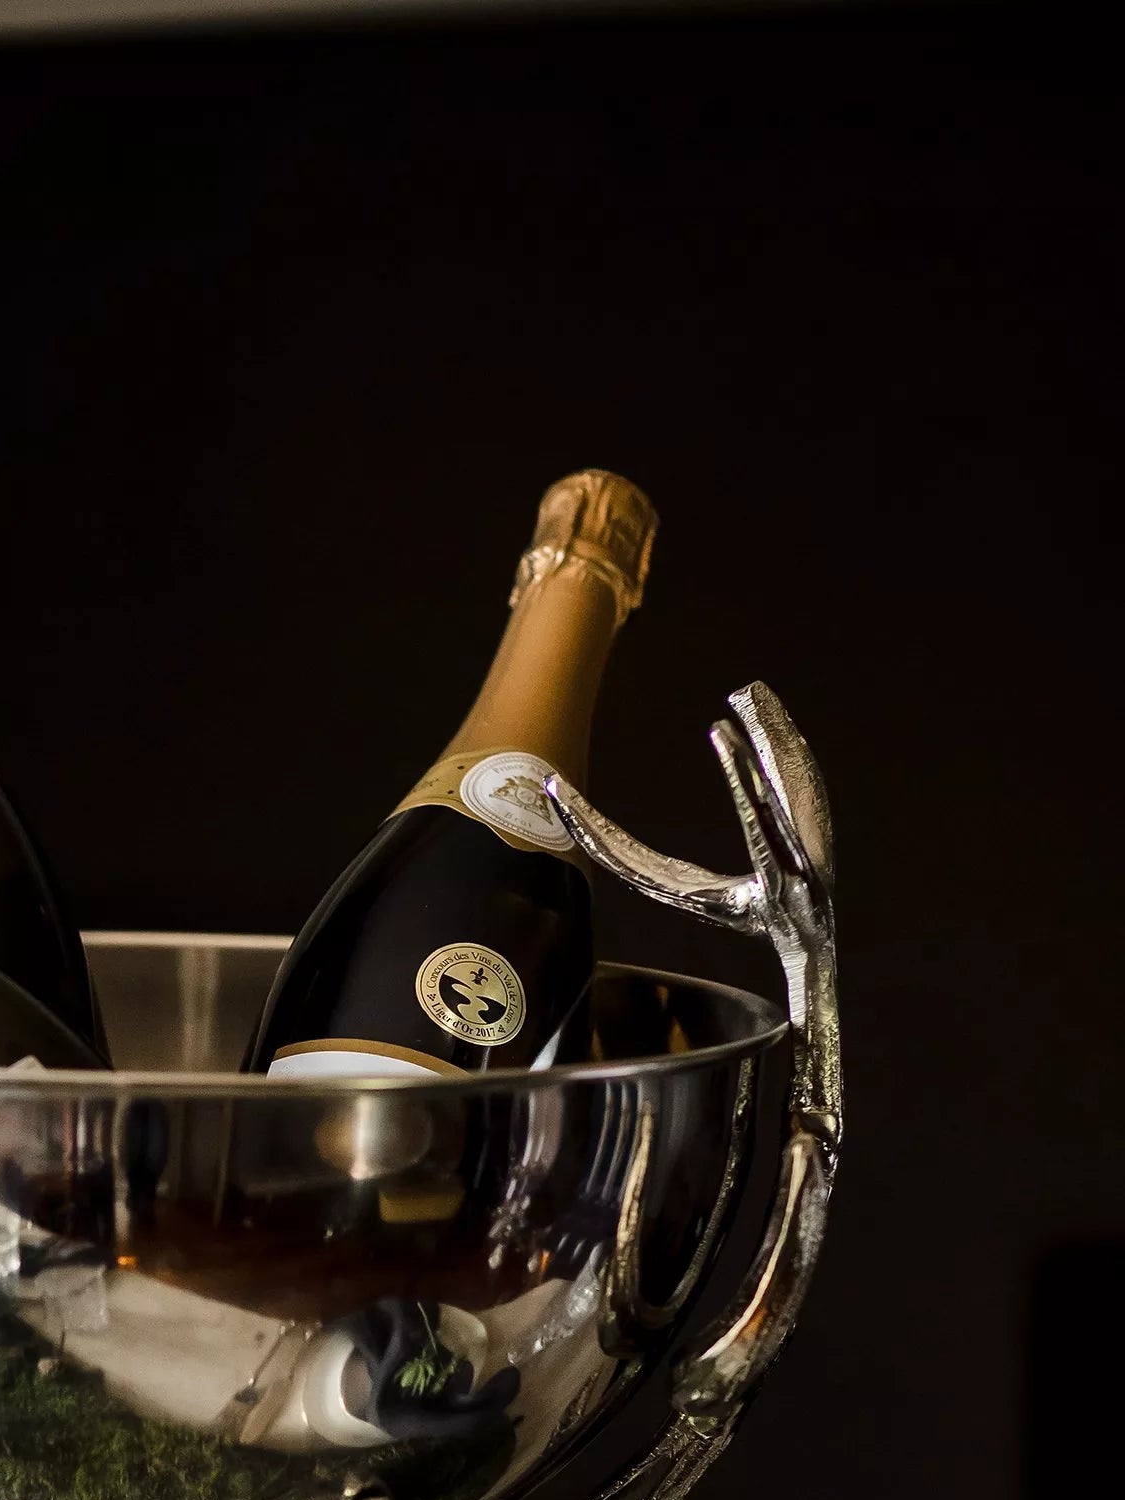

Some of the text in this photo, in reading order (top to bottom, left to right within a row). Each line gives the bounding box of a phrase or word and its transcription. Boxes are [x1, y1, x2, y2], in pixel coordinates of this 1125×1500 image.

[427, 951, 518, 1024] Concours des Vins du Val de Loire
[431, 1002, 452, 1021] Liger
[475, 1027, 496, 1038] 2017
